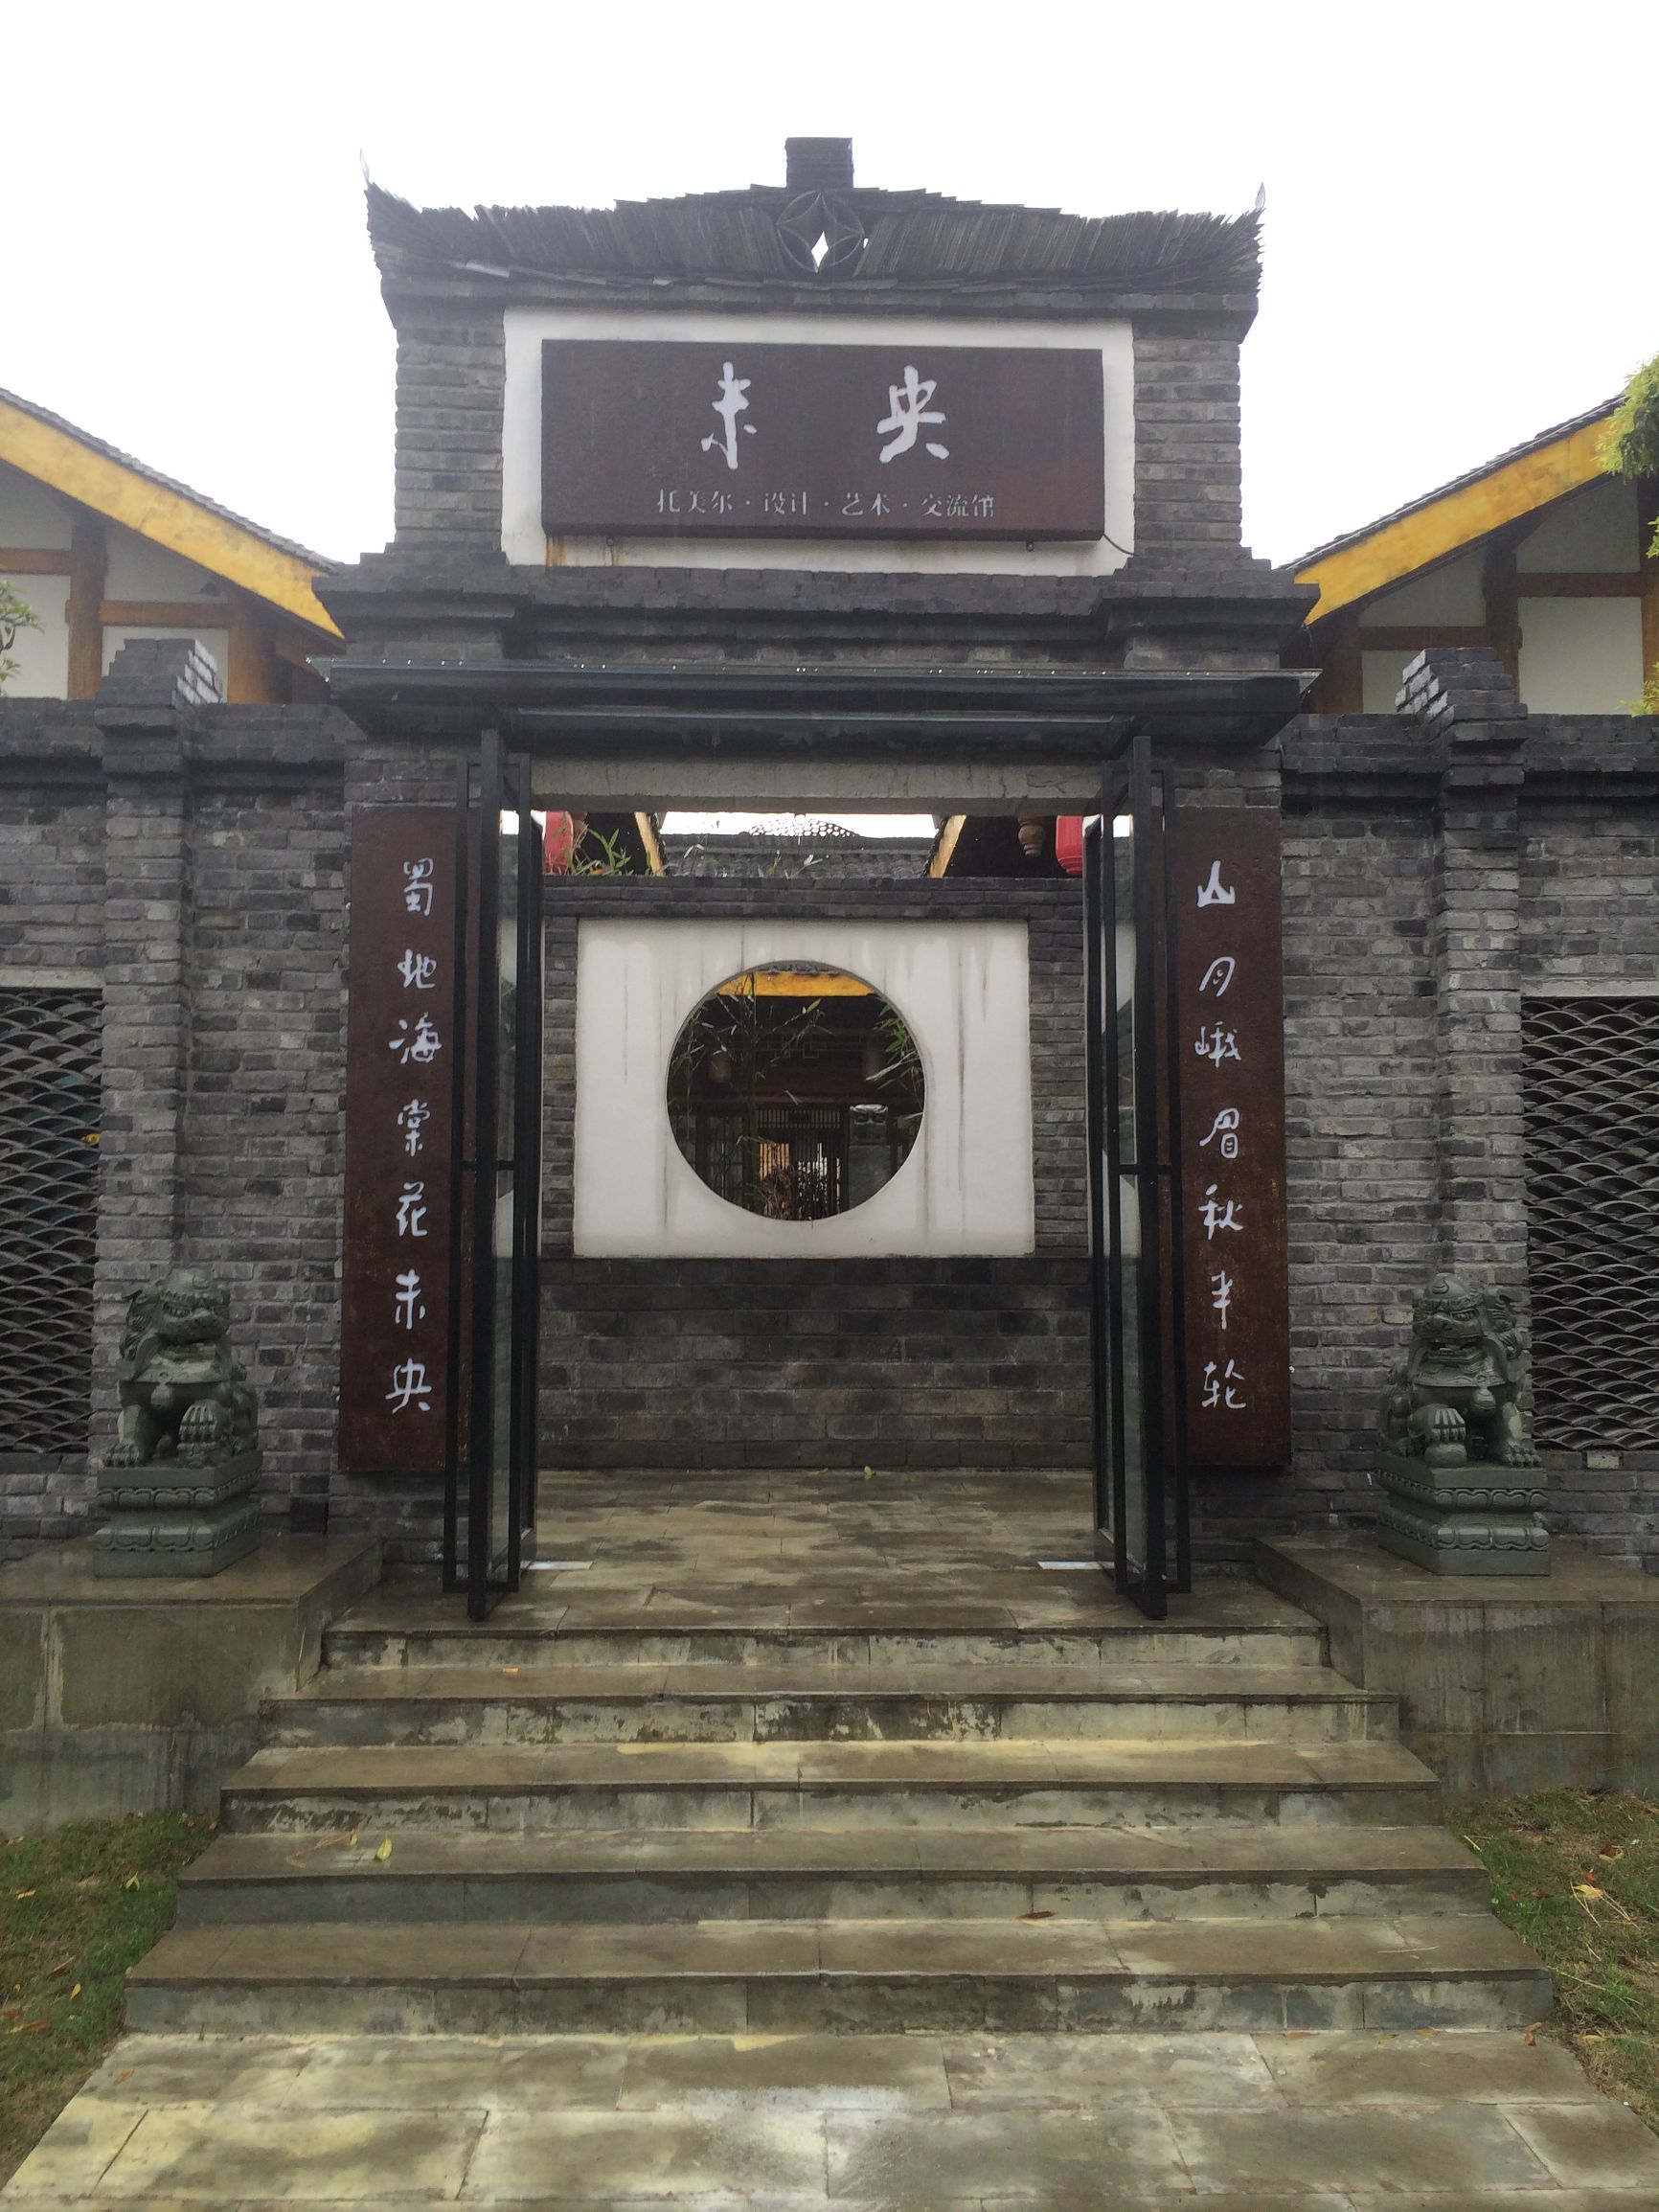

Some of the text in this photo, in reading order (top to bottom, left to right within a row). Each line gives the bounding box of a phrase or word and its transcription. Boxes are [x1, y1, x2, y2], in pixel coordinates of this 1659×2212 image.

[700, 361, 949, 469] 未央
[386, 857, 443, 1414] 蜀地海棠花未央
[1194, 860, 1246, 1409] 山月峨眉秋半轮
